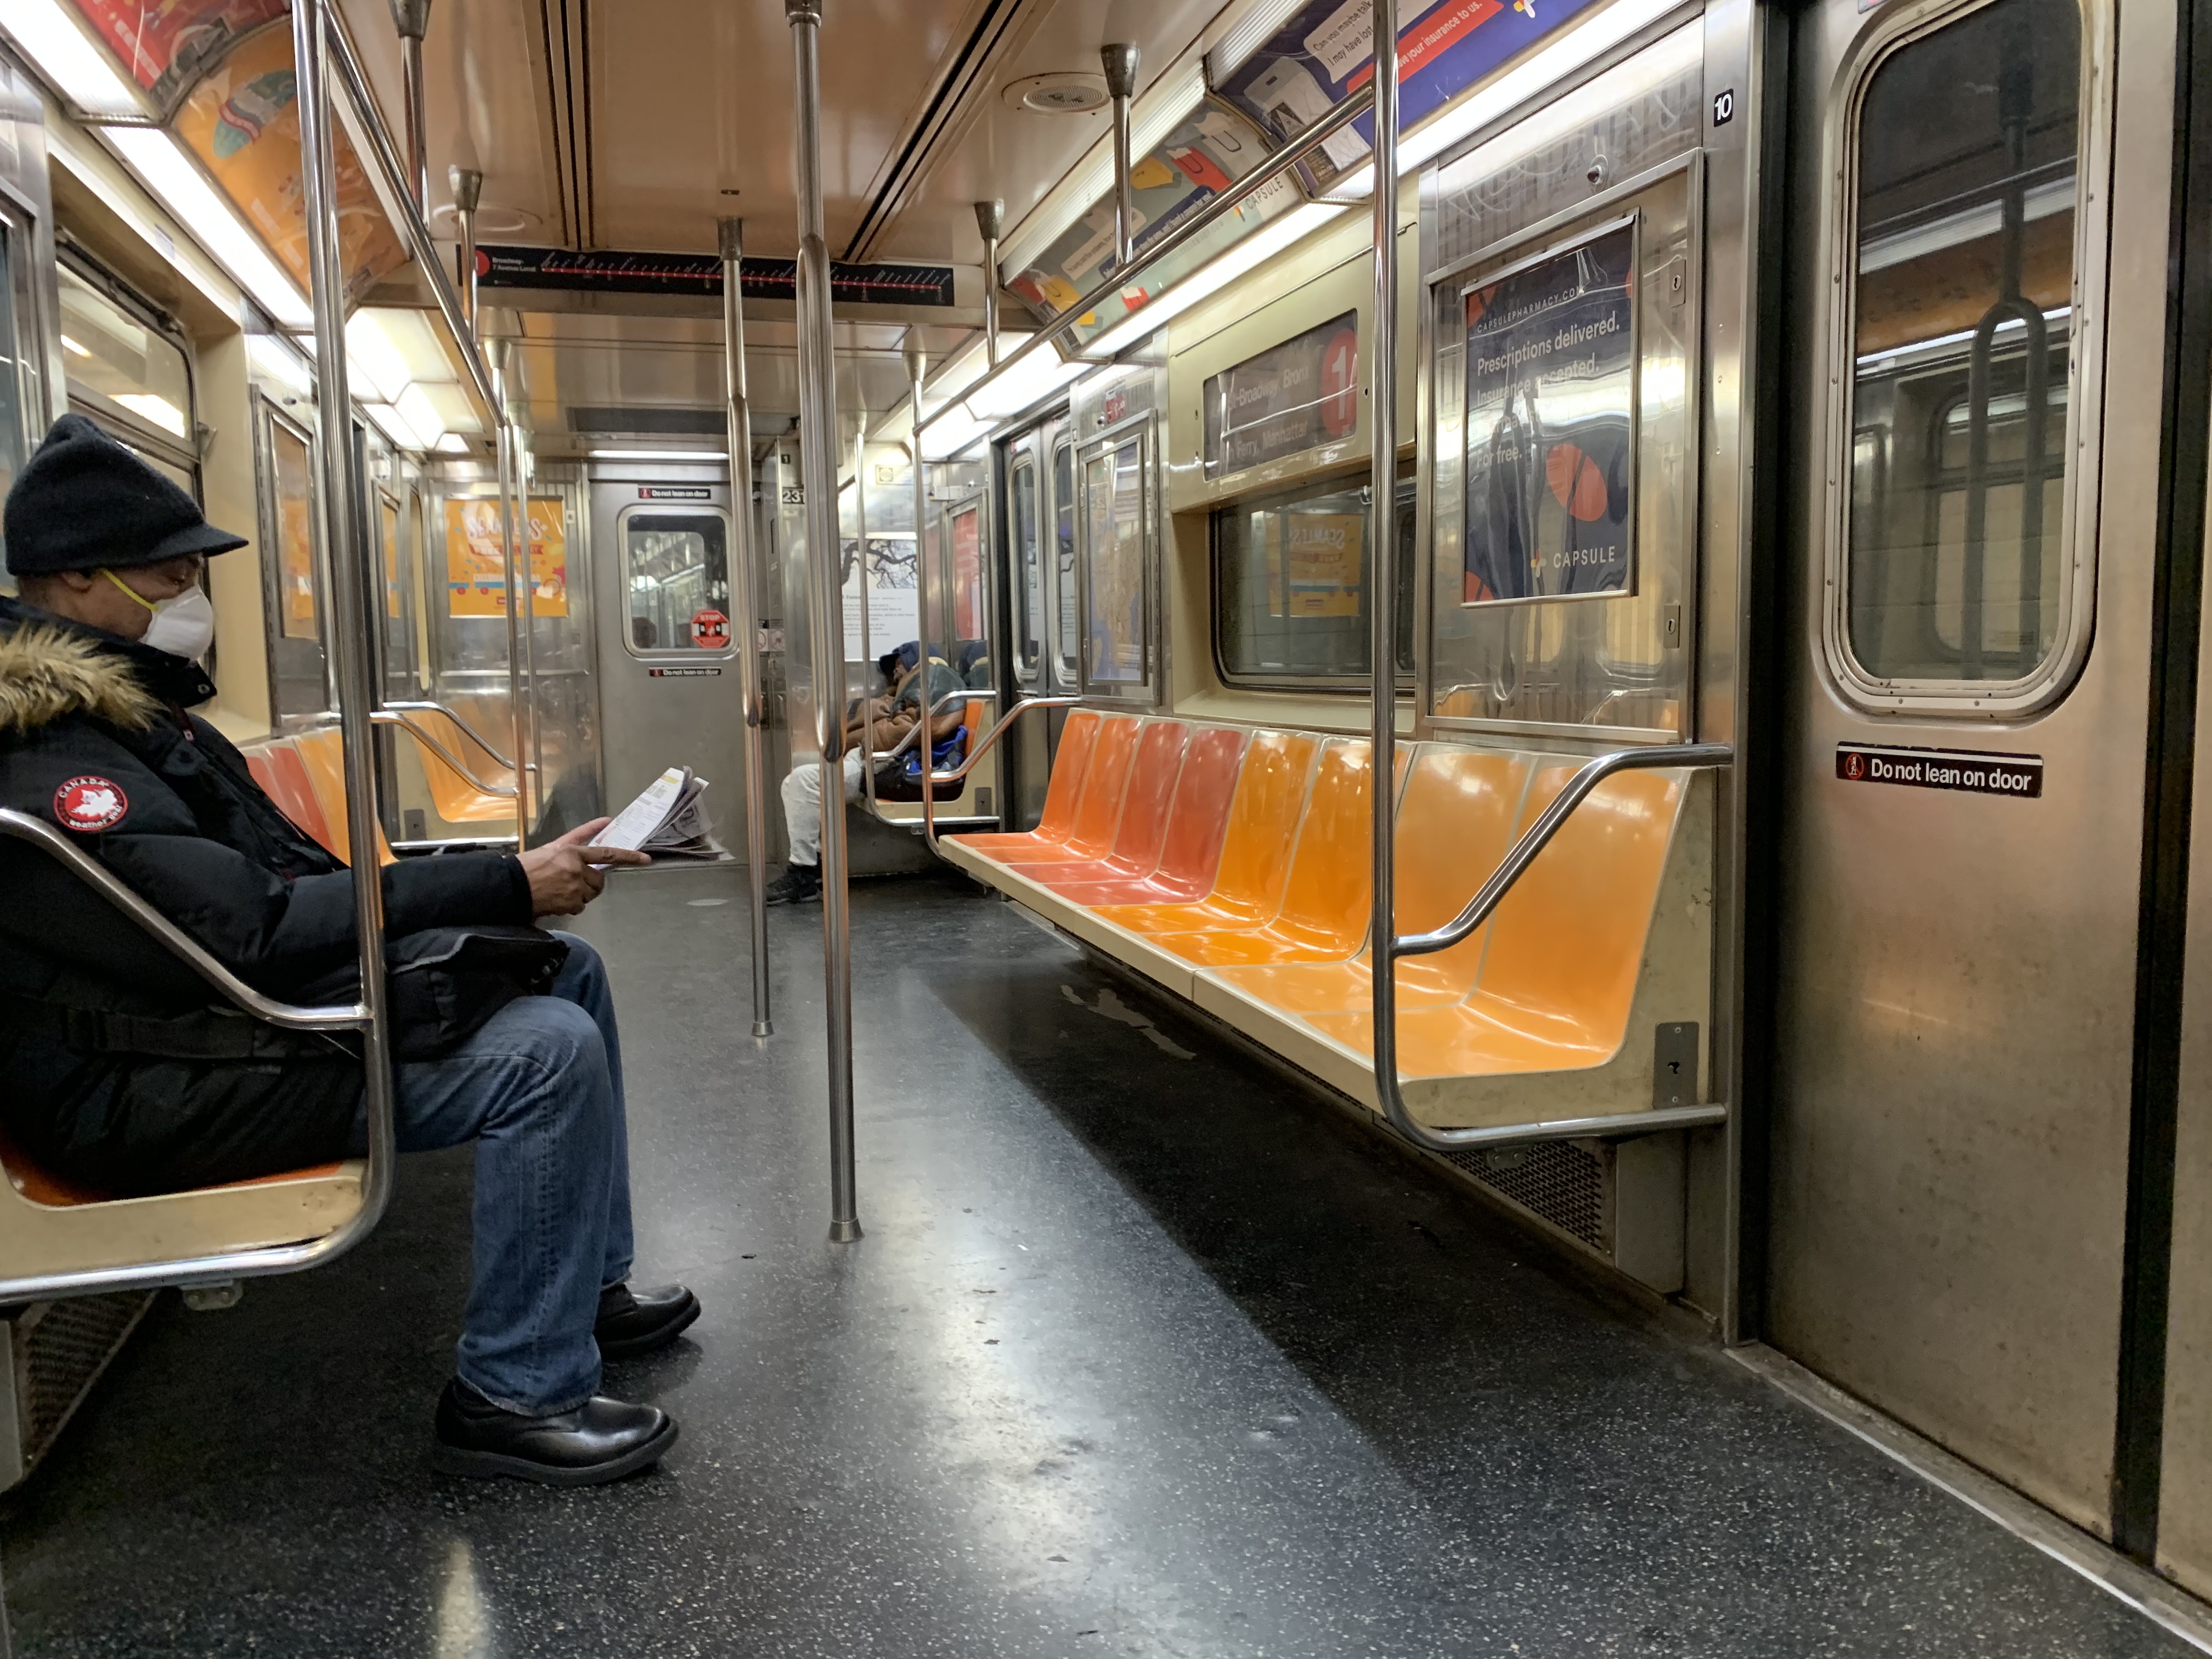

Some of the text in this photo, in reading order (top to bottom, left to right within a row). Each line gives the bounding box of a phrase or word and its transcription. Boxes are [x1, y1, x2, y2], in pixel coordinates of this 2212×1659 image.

[1313, 40, 1329, 51] Can
[1327, 30, 1340, 44] you
[1338, 12, 1361, 32] maybe
[1327, 26, 1373, 66] I may have lost
[1407, 42, 1425, 62] your
[1421, 16, 1460, 47] insurance
[1457, 9, 1470, 20] to
[1467, 1, 1483, 13] us.
[1715, 93, 1733, 121] 10
[1246, 176, 1283, 210] CAPSULE
[1477, 310, 1620, 376] Prescriptions delivered.
[1331, 346, 1347, 421] 1
[1477, 352, 1600, 407] Insurance accepted.
[1476, 445, 1522, 468] For free.
[1553, 546, 1615, 569] CAPSULE
[1871, 758, 2032, 791] Do not lean on door
